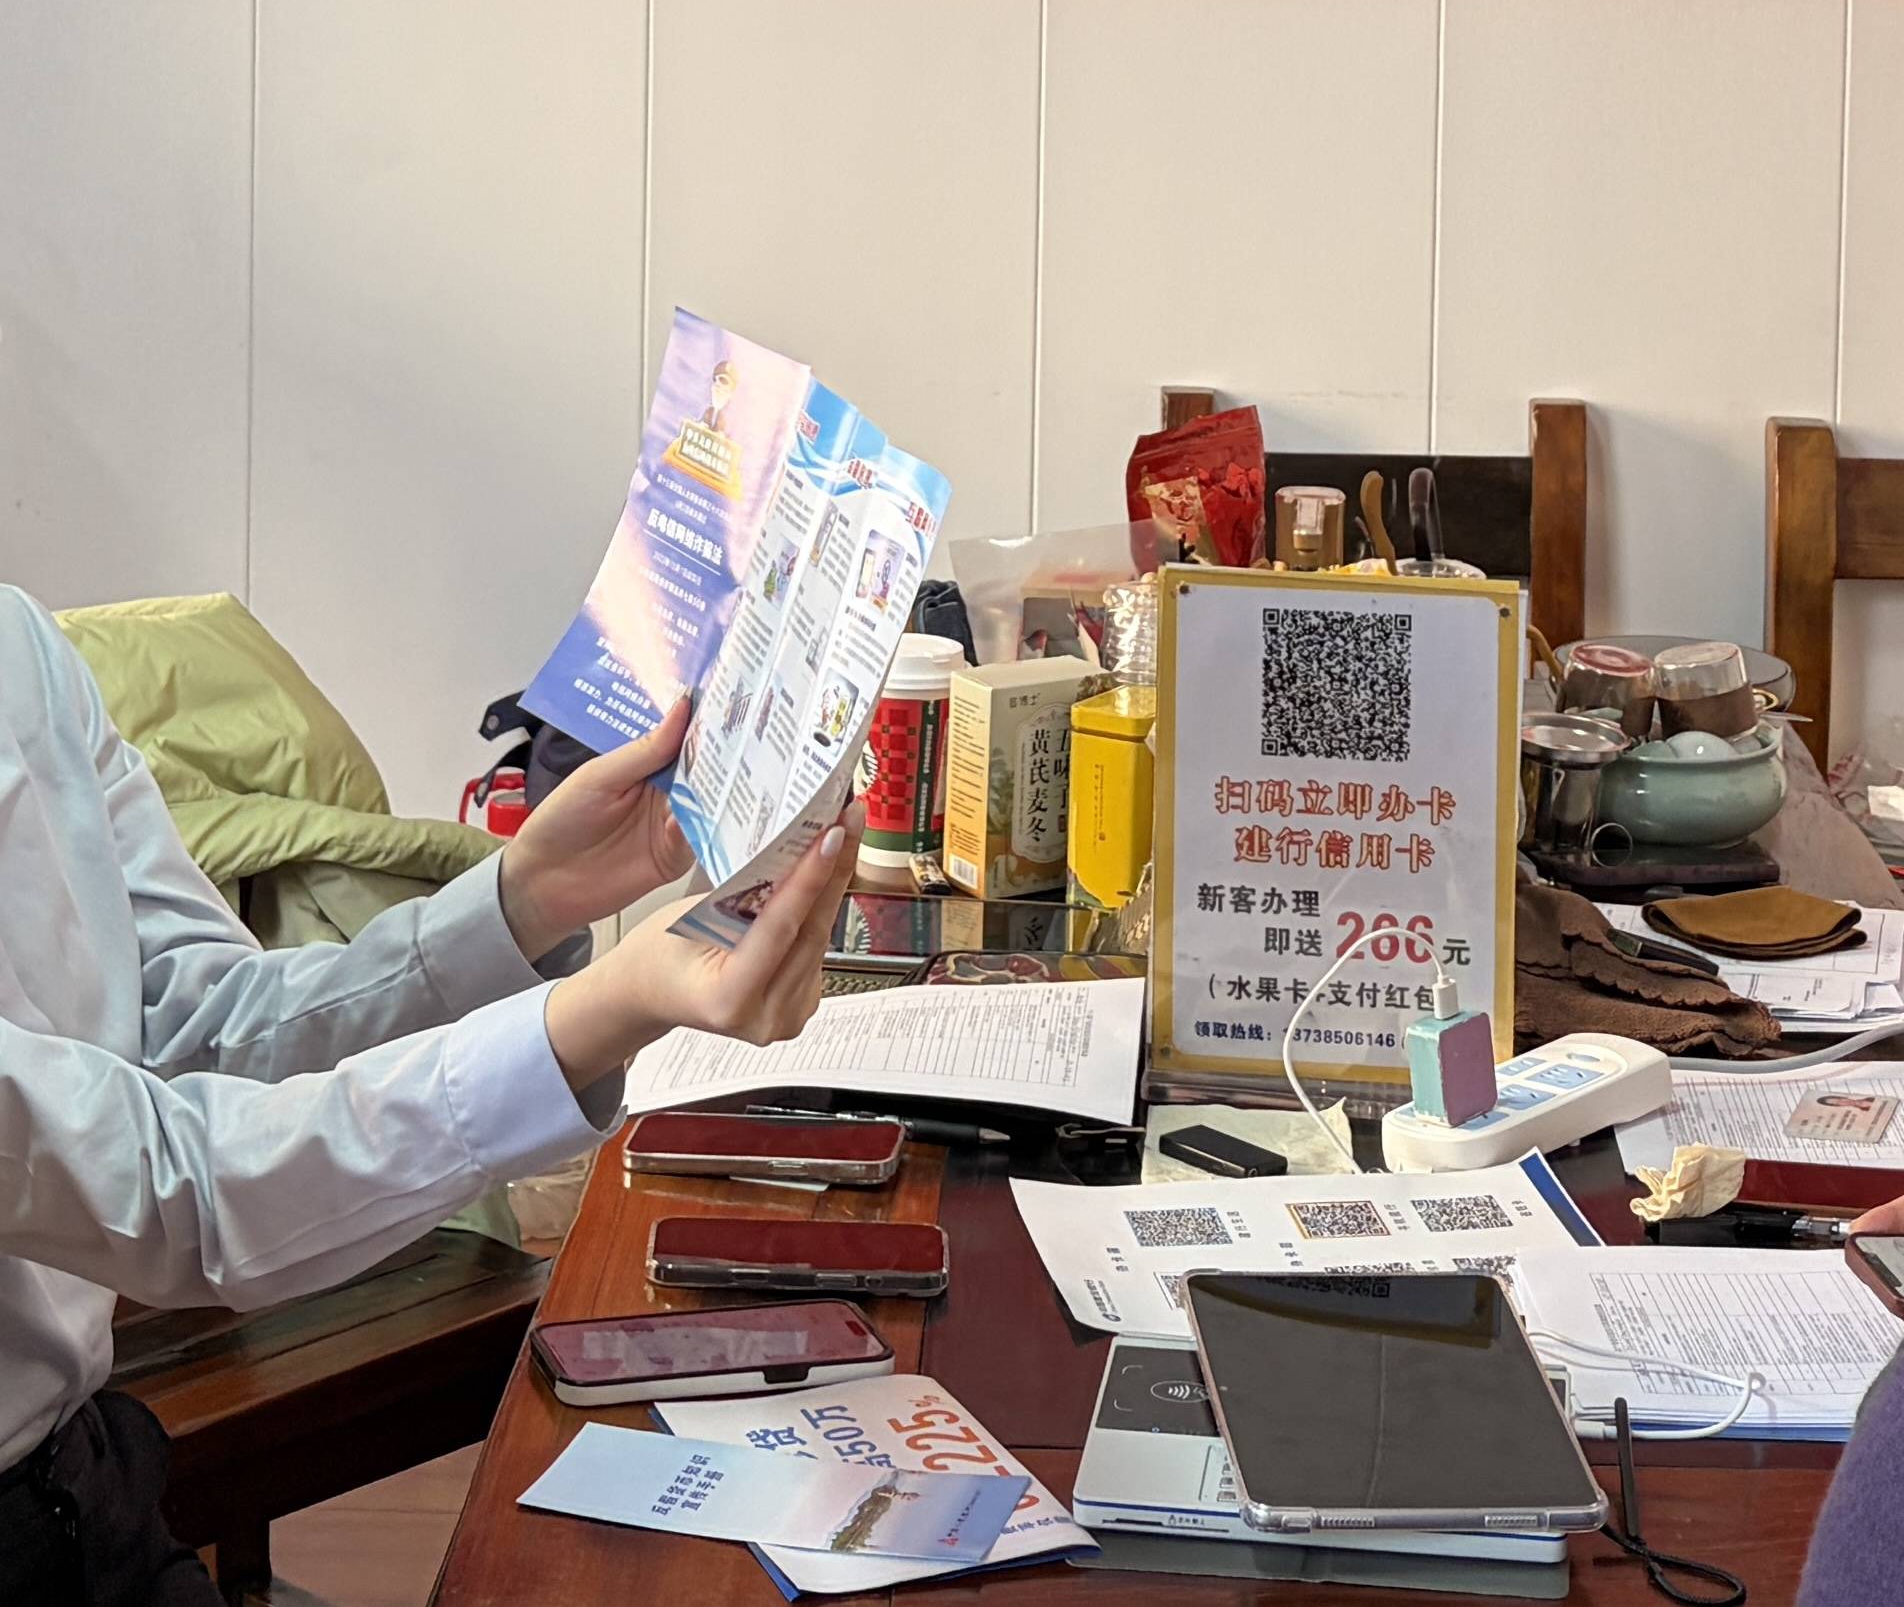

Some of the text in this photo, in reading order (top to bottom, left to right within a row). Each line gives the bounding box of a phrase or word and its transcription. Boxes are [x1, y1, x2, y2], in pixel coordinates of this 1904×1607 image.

[1026, 729, 1051, 843] 黄芪麦冬
[1214, 776, 1457, 826] 扫码立即办卡
[1234, 825, 1436, 874] 建行信用卡
[1197, 883, 1321, 917] 新客办理
